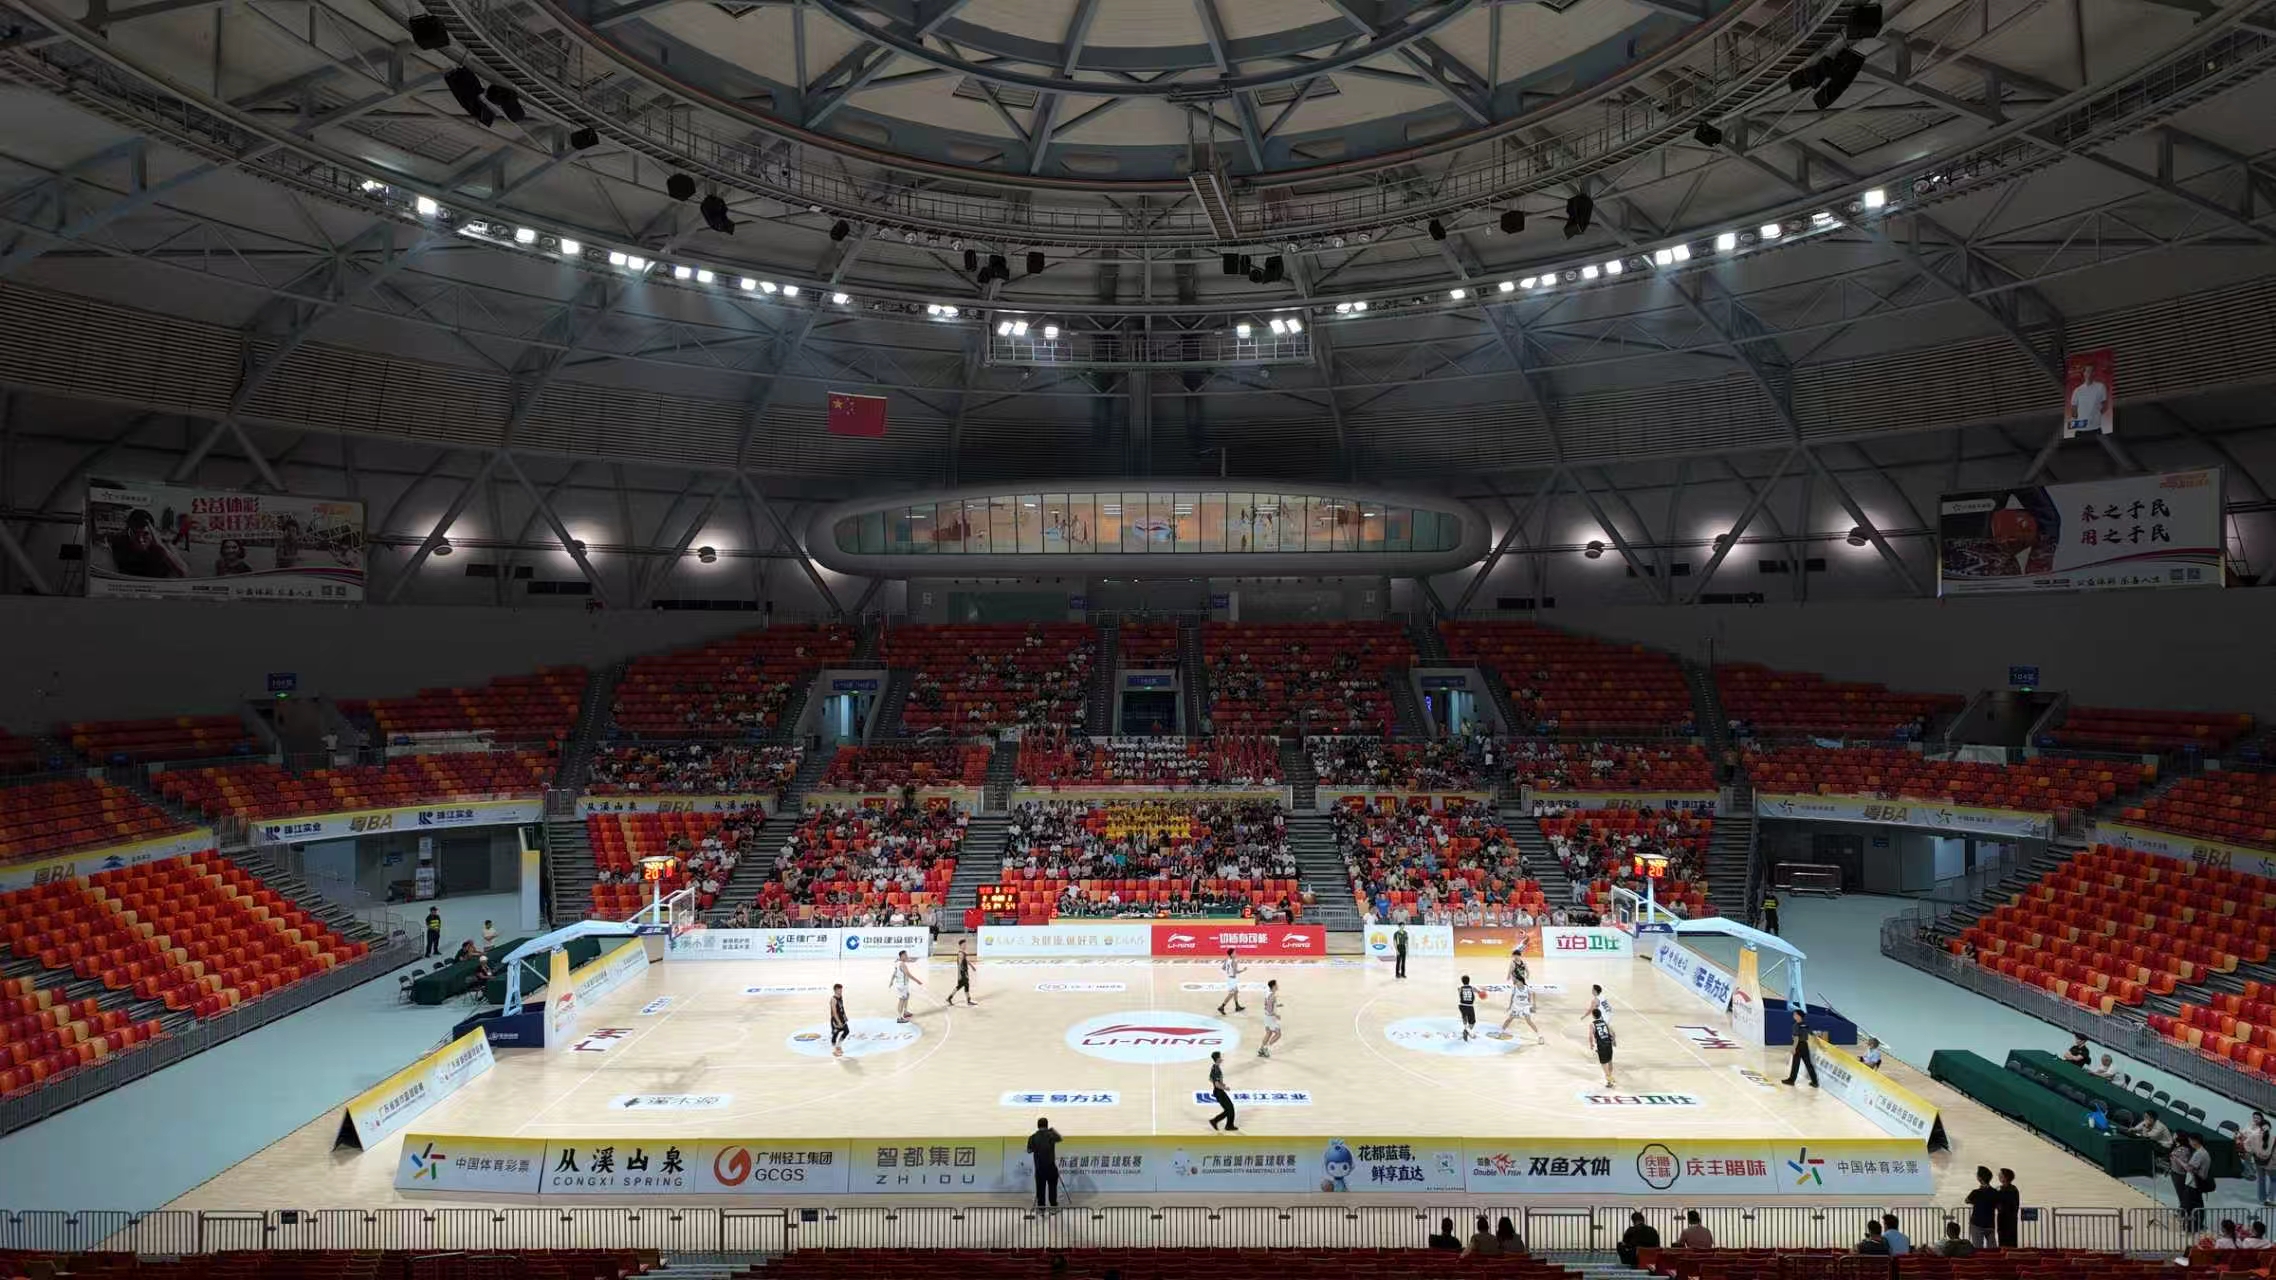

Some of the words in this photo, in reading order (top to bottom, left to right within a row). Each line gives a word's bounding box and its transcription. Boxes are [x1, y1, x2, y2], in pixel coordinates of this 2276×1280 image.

[644, 869, 659, 880] 20
[1648, 866, 1664, 877] 20
[1556, 934, 1620, 950] 立白卫仕
[1081, 1037, 1224, 1046] LI-NING
[554, 1145, 685, 1175] 从溪山泉
[756, 1151, 833, 1166] 广州轻工集团
[877, 1146, 976, 1168] 智都集团
[1058, 1155, 1143, 1168] 东省城市篮球联赛
[1202, 1154, 1297, 1167] 广东省城市篮球联赛
[455, 1157, 531, 1173] 中国体育彩票
[1528, 1156, 1611, 1177] 双鱼文体
[1837, 1159, 1920, 1175] 中国体育彩票
[553, 1176, 615, 1187] CONGXI
[623, 1176, 683, 1187] SPRING
[754, 1168, 805, 1182] GCGS
[1371, 1165, 1425, 1183] 鲜享直达
